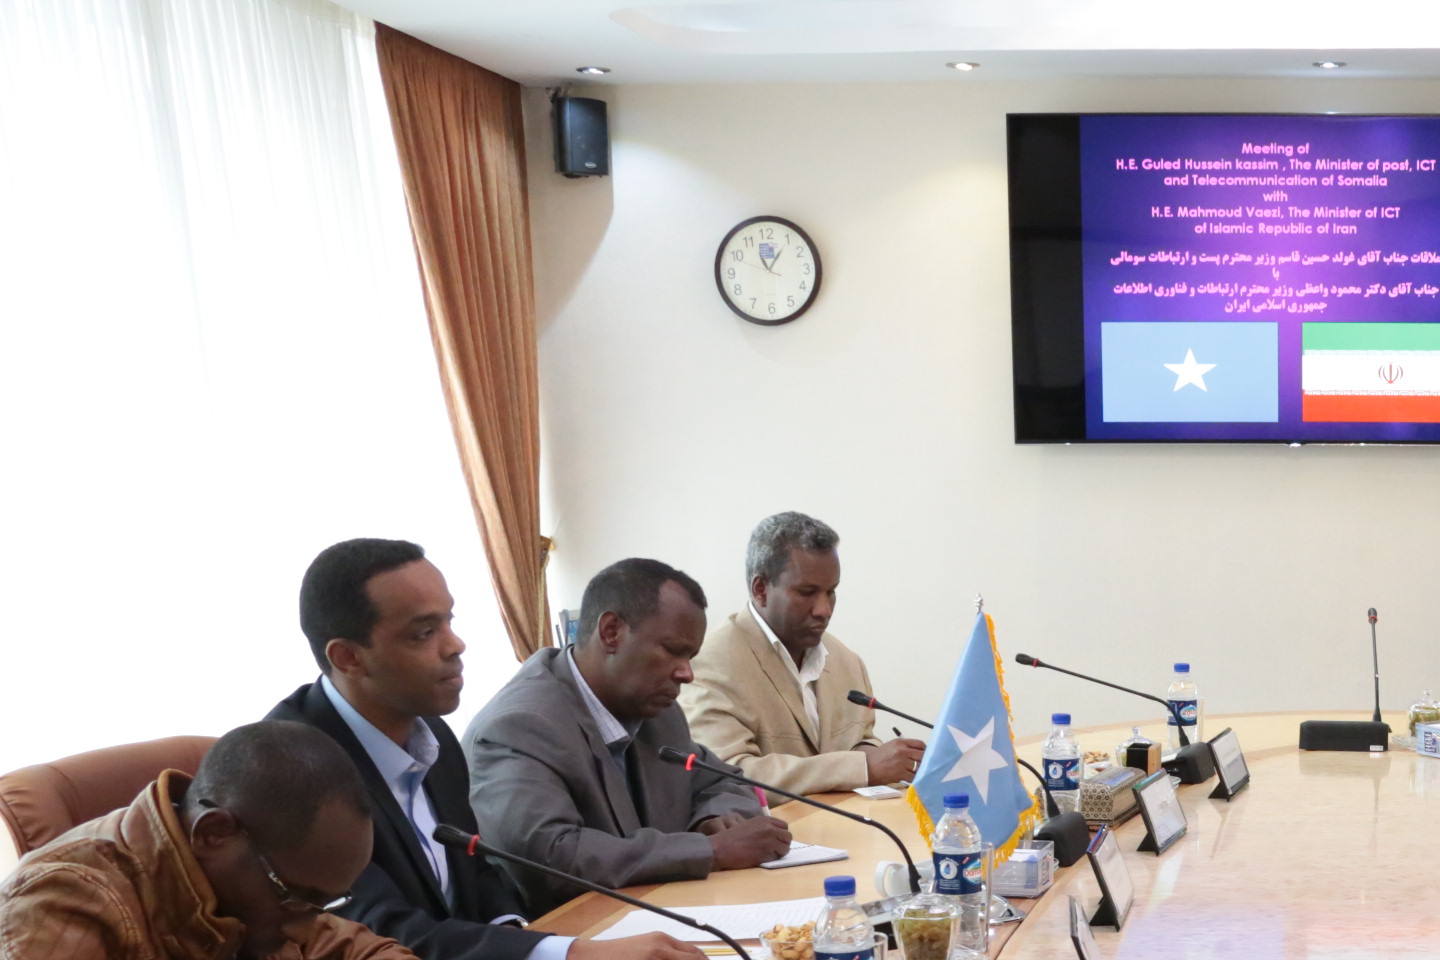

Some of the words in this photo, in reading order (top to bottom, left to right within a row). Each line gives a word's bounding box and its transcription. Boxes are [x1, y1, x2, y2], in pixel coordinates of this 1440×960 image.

[1241, 142, 1294, 157] Meeting
[1296, 142, 1310, 155] of
[1115, 157, 1139, 171] H.E.
[1141, 157, 1181, 171] Guled
[1184, 157, 1233, 171] Hussein
[1288, 158, 1312, 171] The
[1314, 158, 1364, 171] Minister
[1366, 158, 1380, 171] of
[1382, 158, 1413, 174] post,
[1416, 158, 1437, 172] ICT
[1163, 173, 1189, 186] and
[1191, 173, 1318, 186] Telecommunication
[1321, 173, 1335, 186] of
[1337, 174, 1388, 187] Somalia
[1262, 190, 1289, 202] with
[1151, 205, 1174, 218] H.E.
[1177, 205, 1243, 218] Mahmoud
[1245, 205, 1285, 219] Vaezi,
[1287, 205, 1311, 218] The
[1313, 205, 1362, 219] Minister
[1364, 206, 1378, 219] of
[1380, 206, 1401, 219] ICT
[759, 228, 775, 240] 12
[1194, 221, 1208, 234] of
[1209, 221, 1254, 234] Islamic
[1258, 222, 1313, 237] Republic
[1316, 222, 1330, 234] of
[1332, 222, 1358, 235] Iran
[743, 236, 754, 247] 11
[785, 234, 790, 245] 1
[731, 250, 744, 261] 10
[796, 246, 804, 258] 2
[1110, 250, 1146, 266] سومالی
[1147, 250, 1190, 266] ارتباطات
[1198, 252, 1221, 266] پست
[1222, 252, 1253, 266] محترم
[1277, 250, 1301, 266] قاسم
[1356, 250, 1382, 267] آقای
[1382, 251, 1409, 267] جناب
[1190, 254, 1198, 266] و
[1254, 253, 1276, 266] وزیر
[1301, 254, 1330, 266] حسین
[728, 268, 736, 279] 9
[803, 263, 810, 275] 3
[1271, 266, 1280, 281] با
[734, 284, 742, 295] 8
[799, 280, 806, 291] 4
[1113, 282, 1153, 295] اطلاعات
[1153, 281, 1188, 298] فناوری
[1189, 286, 1196, 298] و
[1196, 282, 1239, 298] ارتباطات
[1239, 284, 1270, 297] محترم
[1271, 284, 1294, 298] وزیر
[1295, 282, 1329, 298] واعظی
[1330, 285, 1362, 298] محمود
[1363, 282, 1387, 298] دکتر
[1387, 281, 1413, 298] آقای
[1413, 283, 1440, 299] جناب
[749, 298, 757, 309] 7
[768, 303, 776, 314] 6
[787, 296, 795, 307] 5
[1224, 298, 1251, 313] ایران
[1251, 298, 1286, 314] اسلامی
[1287, 301, 1328, 314] جمهوری
